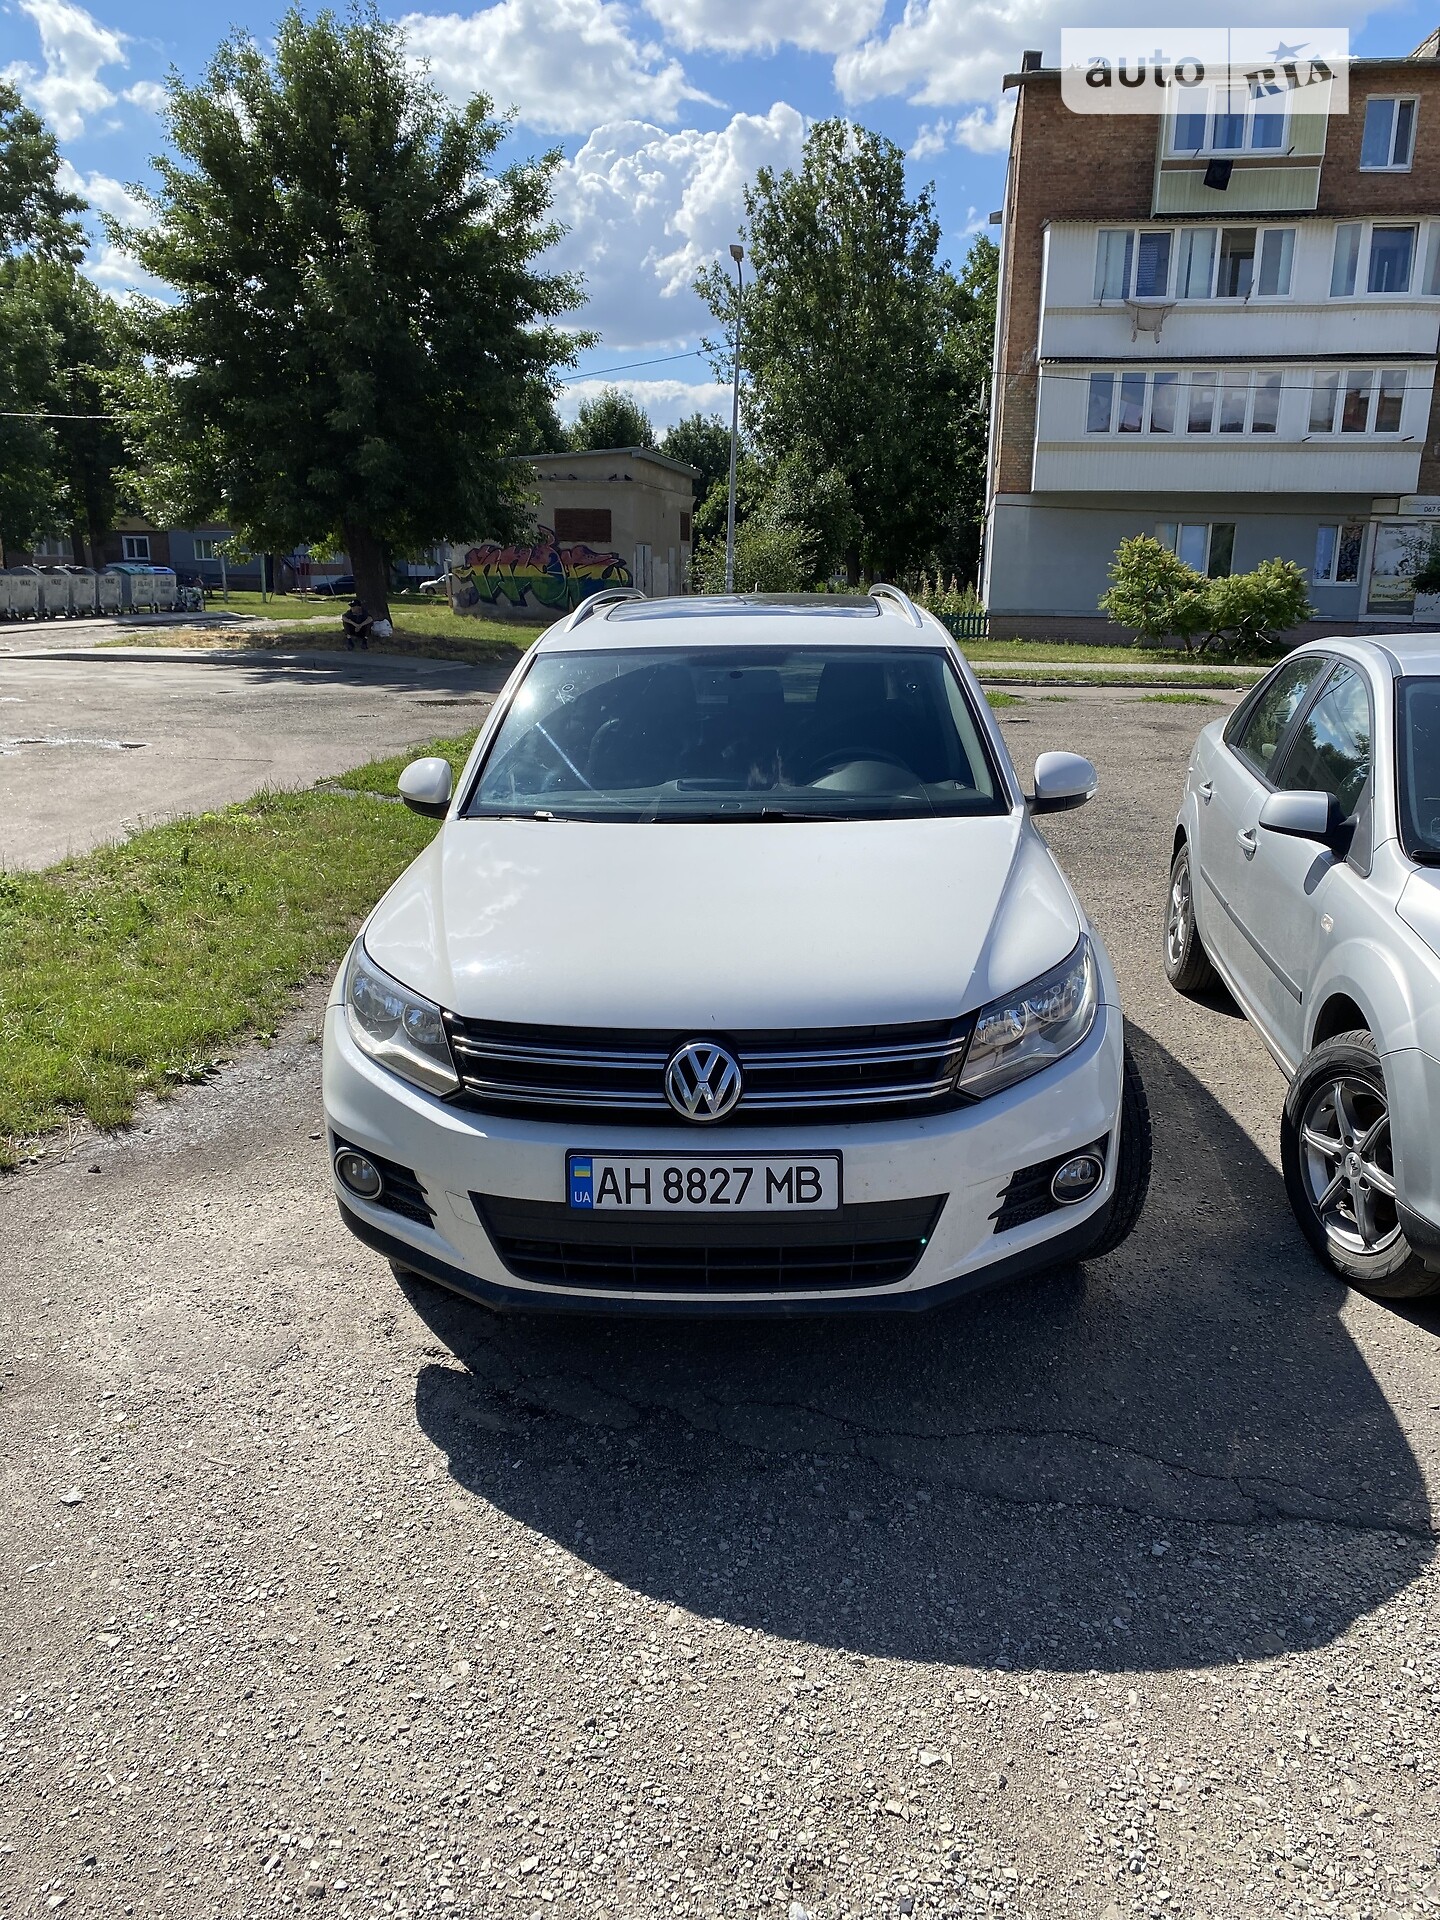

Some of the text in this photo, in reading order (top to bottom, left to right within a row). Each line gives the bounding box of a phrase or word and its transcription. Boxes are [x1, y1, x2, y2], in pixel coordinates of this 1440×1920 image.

[574, 1191, 591, 1203] UA
[596, 1166, 823, 1204] AH 8827 MB
